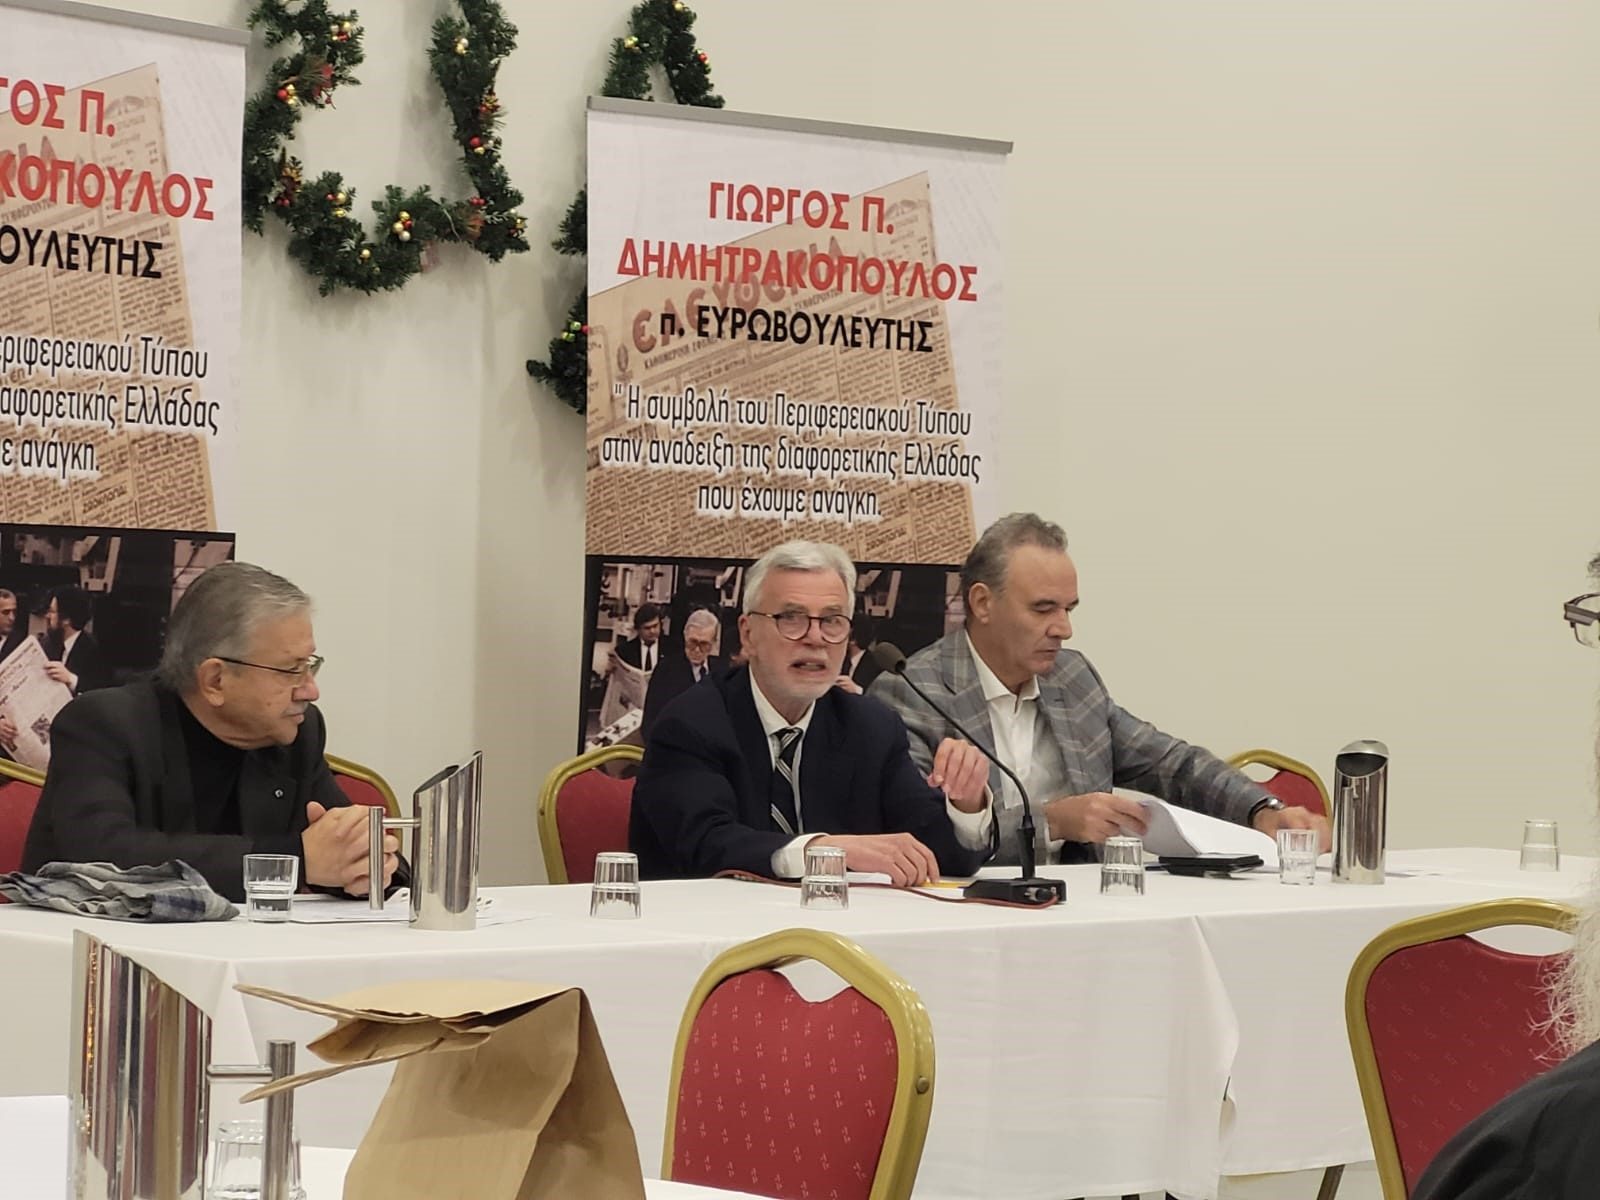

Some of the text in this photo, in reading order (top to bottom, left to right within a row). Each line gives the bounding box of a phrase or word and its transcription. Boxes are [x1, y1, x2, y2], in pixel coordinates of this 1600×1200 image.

[0, 77, 115, 137] ΟΣ Π.
[710, 181, 894, 235] ΓΙΩΡΓΟΣ Π.
[0, 224, 163, 279] ΟΥΛΕΥΤΗΣ
[617, 238, 977, 301] ΔΗΜΗΤΡΑΚΟΠΟΥΛΟΣ
[697, 305, 934, 353] ΕΥΡΩΒΟΥΛΕΥΤΗΣ
[0, 333, 208, 378] ριφερειακού Τύπου
[0, 382, 220, 436] αφορετικής Ελλάδας
[647, 387, 729, 429] συμβολή
[736, 400, 768, 425] του
[774, 393, 910, 437] Περιφερειακού
[916, 401, 971, 436] Τύπου
[20, 428, 100, 480] ανάγκη.
[602, 436, 643, 464] στην
[741, 443, 772, 473] της
[777, 435, 898, 480] διαφορετικής
[904, 442, 981, 482] Ελλάδας
[698, 480, 883, 523] που έχουμε ανάγκη.
